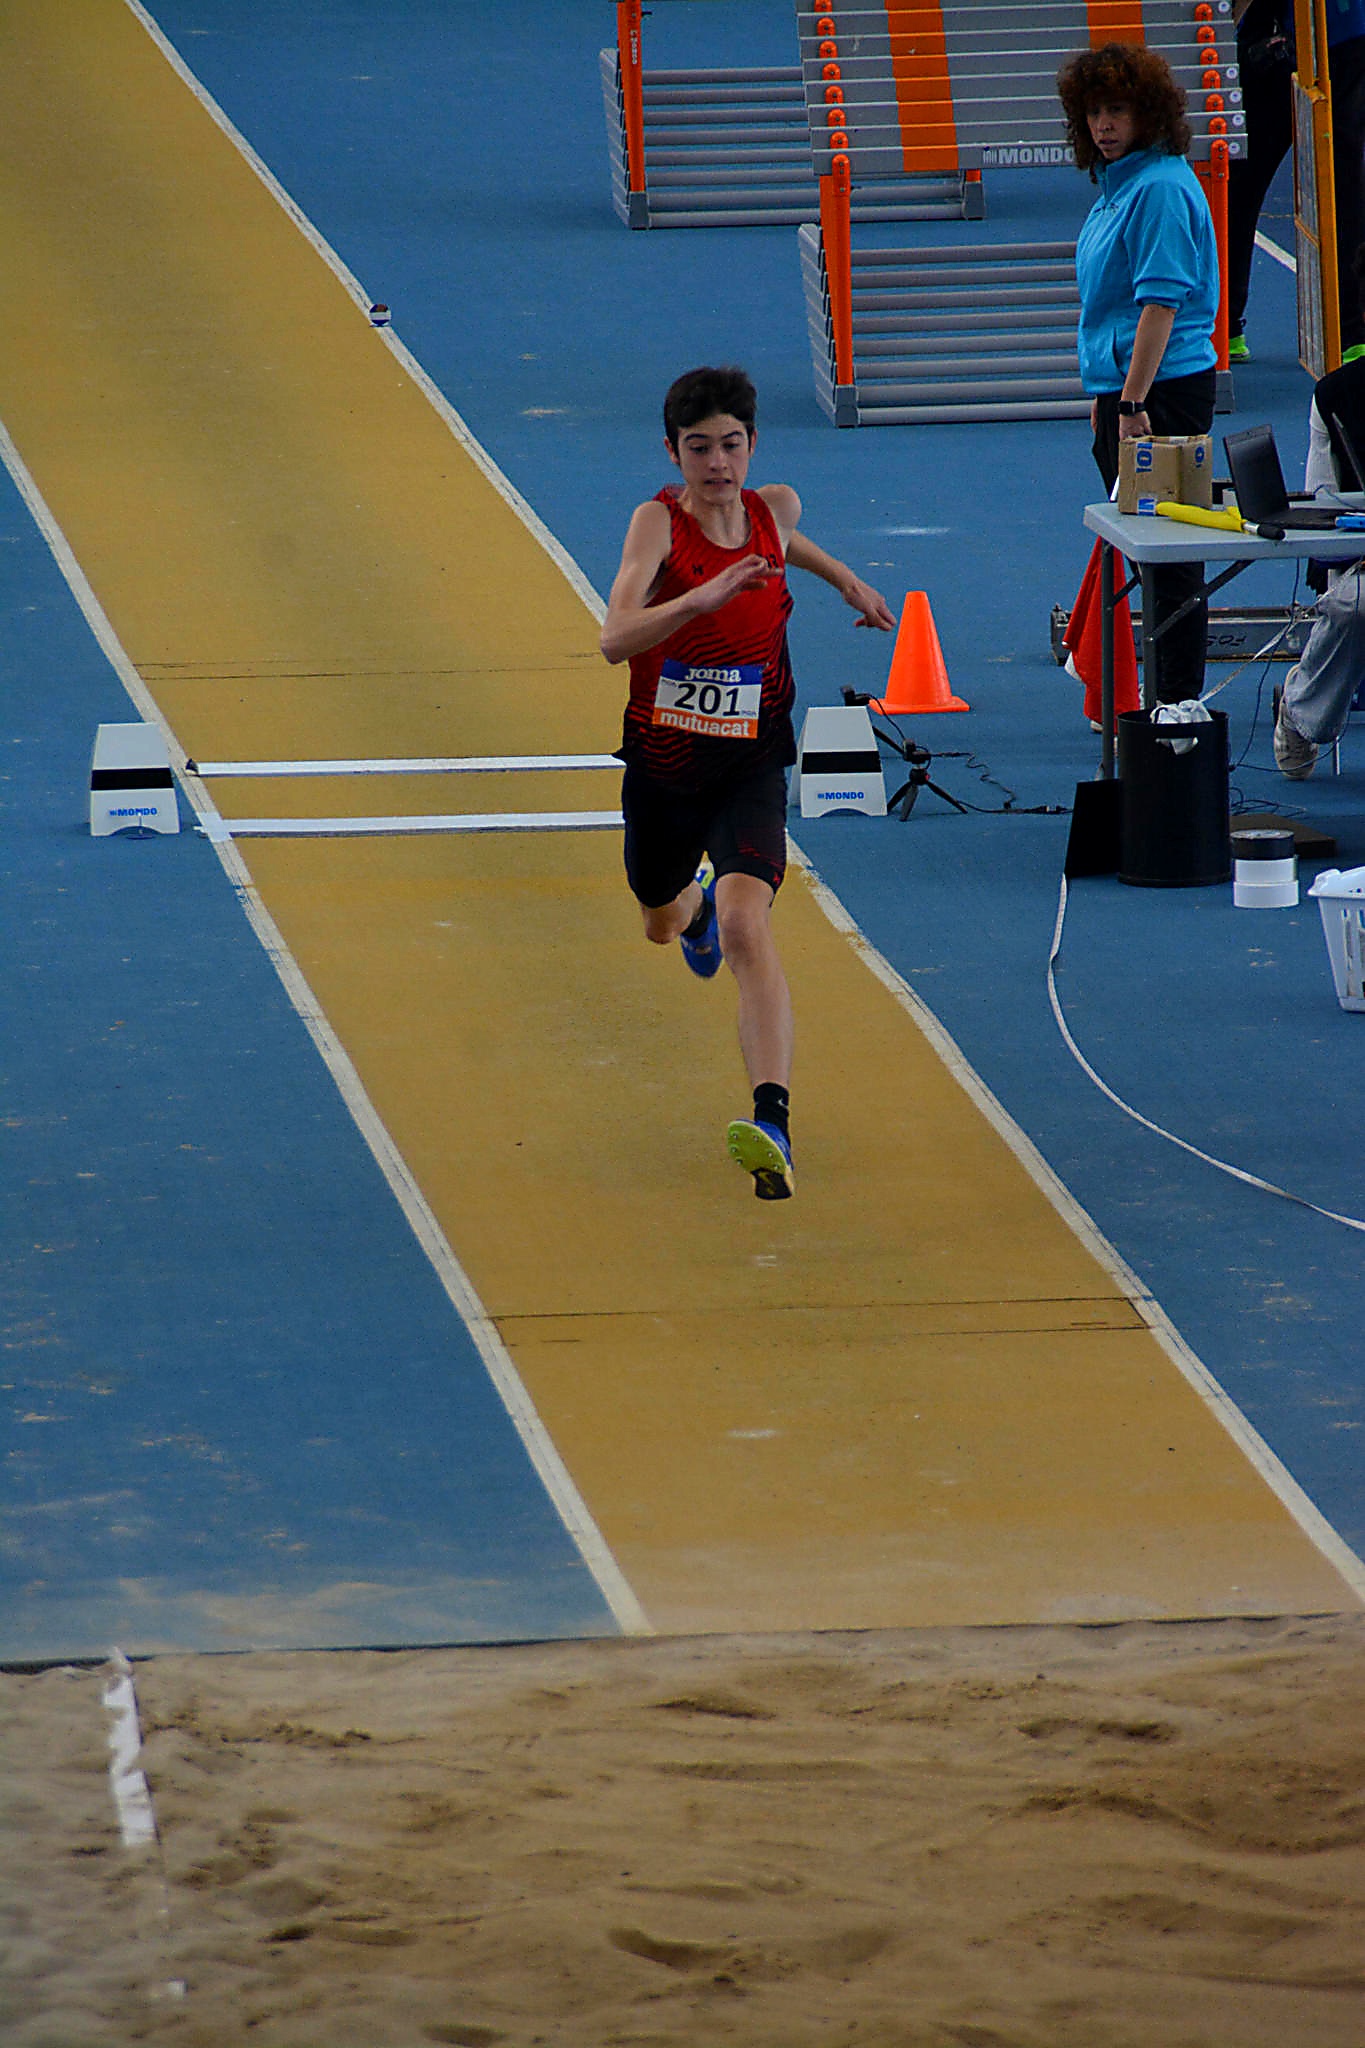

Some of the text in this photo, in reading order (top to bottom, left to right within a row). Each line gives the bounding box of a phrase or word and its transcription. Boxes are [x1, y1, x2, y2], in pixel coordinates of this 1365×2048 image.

[674, 682, 740, 717] 201
[660, 711, 750, 737] mutuacat
[824, 791, 865, 801] MONDO
[117, 807, 158, 817] MONDO
